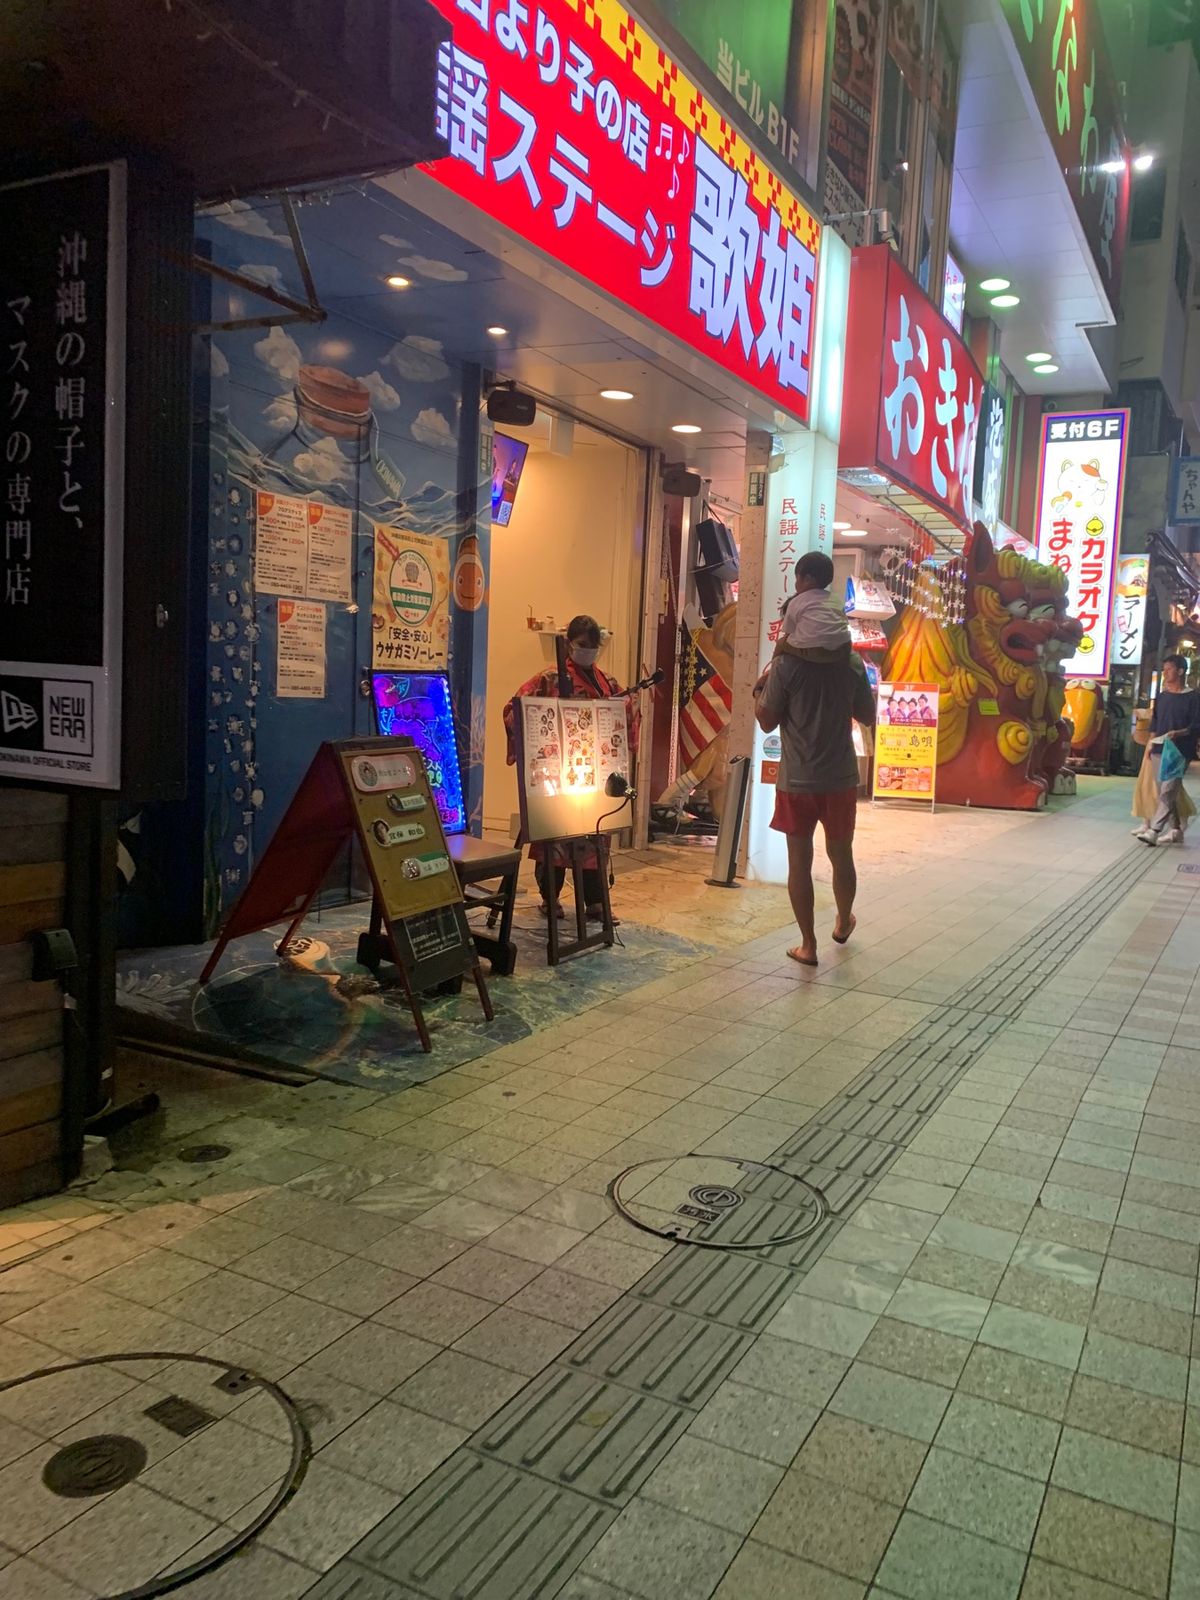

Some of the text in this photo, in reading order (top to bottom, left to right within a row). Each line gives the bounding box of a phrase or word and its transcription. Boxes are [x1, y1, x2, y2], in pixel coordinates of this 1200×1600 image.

[688, 135, 816, 397] 歌姫
[55, 230, 87, 529] 沖縄の帽子と、
[5, 295, 32, 605] マスクの専門店
[1050, 419, 1120, 440] 受付6F
[1076, 537, 1106, 634] カラオケ
[1119, 594, 1141, 660] ラーメン
[376, 642, 443, 660] ウサガミソーレー
[50, 696, 86, 717] NEW
[50, 717, 86, 739] ERA
[32, 756, 65, 769] OFFICIAL
[66, 760, 92, 772] STORE
